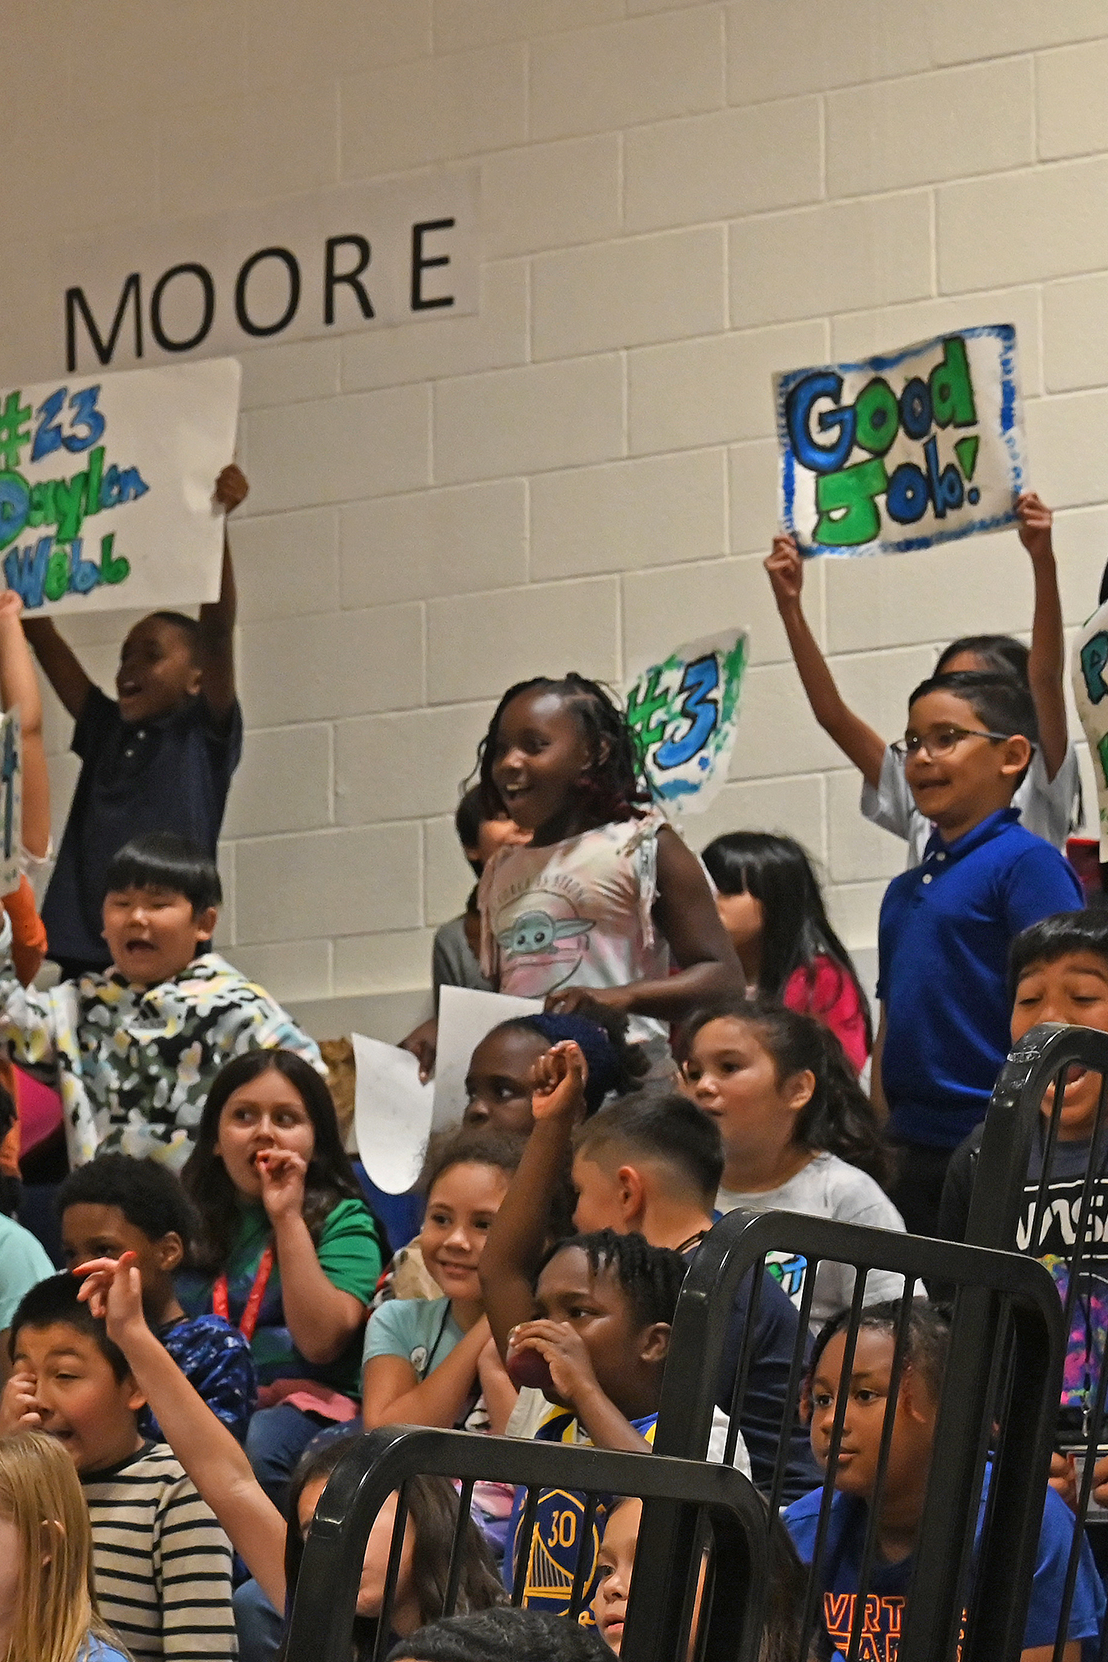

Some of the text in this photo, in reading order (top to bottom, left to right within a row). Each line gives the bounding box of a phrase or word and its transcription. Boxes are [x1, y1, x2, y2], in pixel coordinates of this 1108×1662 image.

[63, 217, 457, 373] MOORE
[791, 335, 978, 474] Good
[3, 532, 130, 609] Webb
[626, 652, 719, 770] #3
[1015, 1194, 1108, 1251] NAS
[547, 1510, 577, 1548] 30
